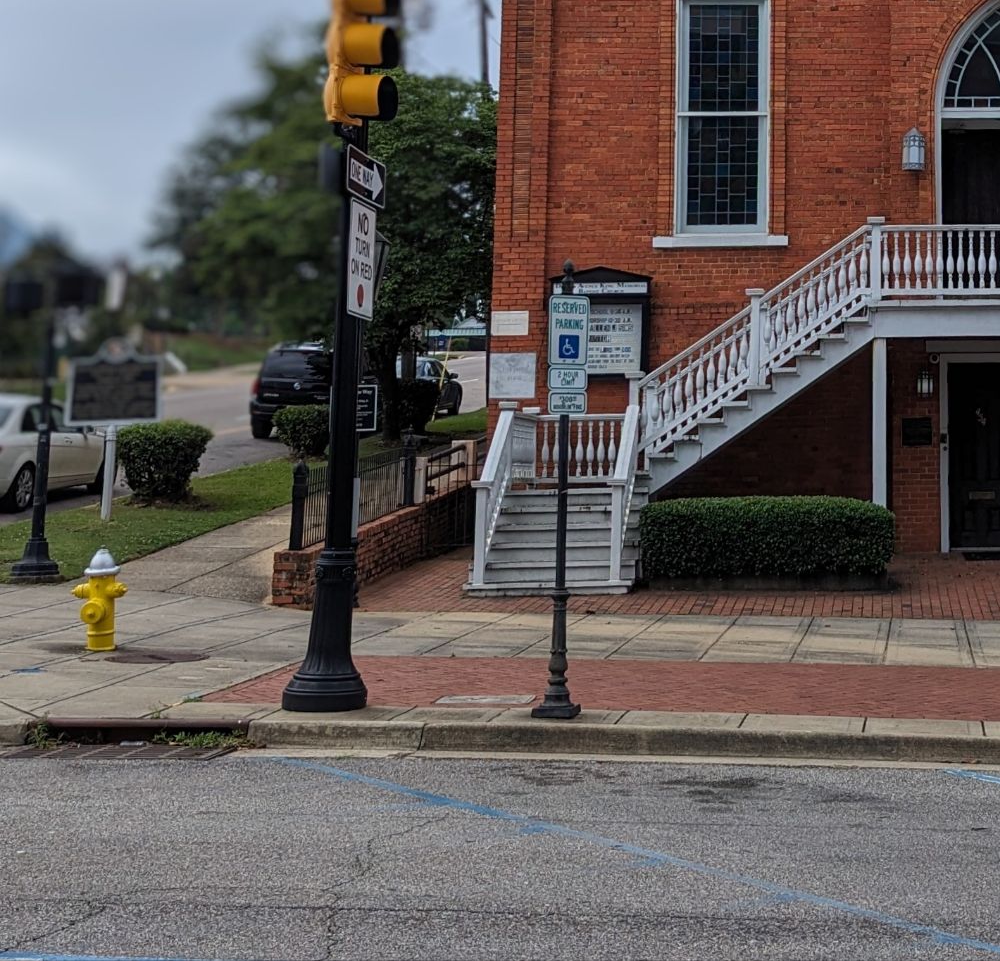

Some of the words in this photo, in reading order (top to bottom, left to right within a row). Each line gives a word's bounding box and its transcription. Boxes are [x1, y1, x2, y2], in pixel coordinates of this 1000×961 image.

[352, 160, 361, 182] ONE
[363, 168, 374, 189] WAY
[357, 212, 369, 236] NO
[355, 237, 370, 258] TURN
[351, 258, 360, 276] ON
[360, 262, 372, 281] RED
[552, 302, 587, 315] RESERVED
[555, 318, 584, 330] PARKING
[560, 378, 576, 386] LIMIT
